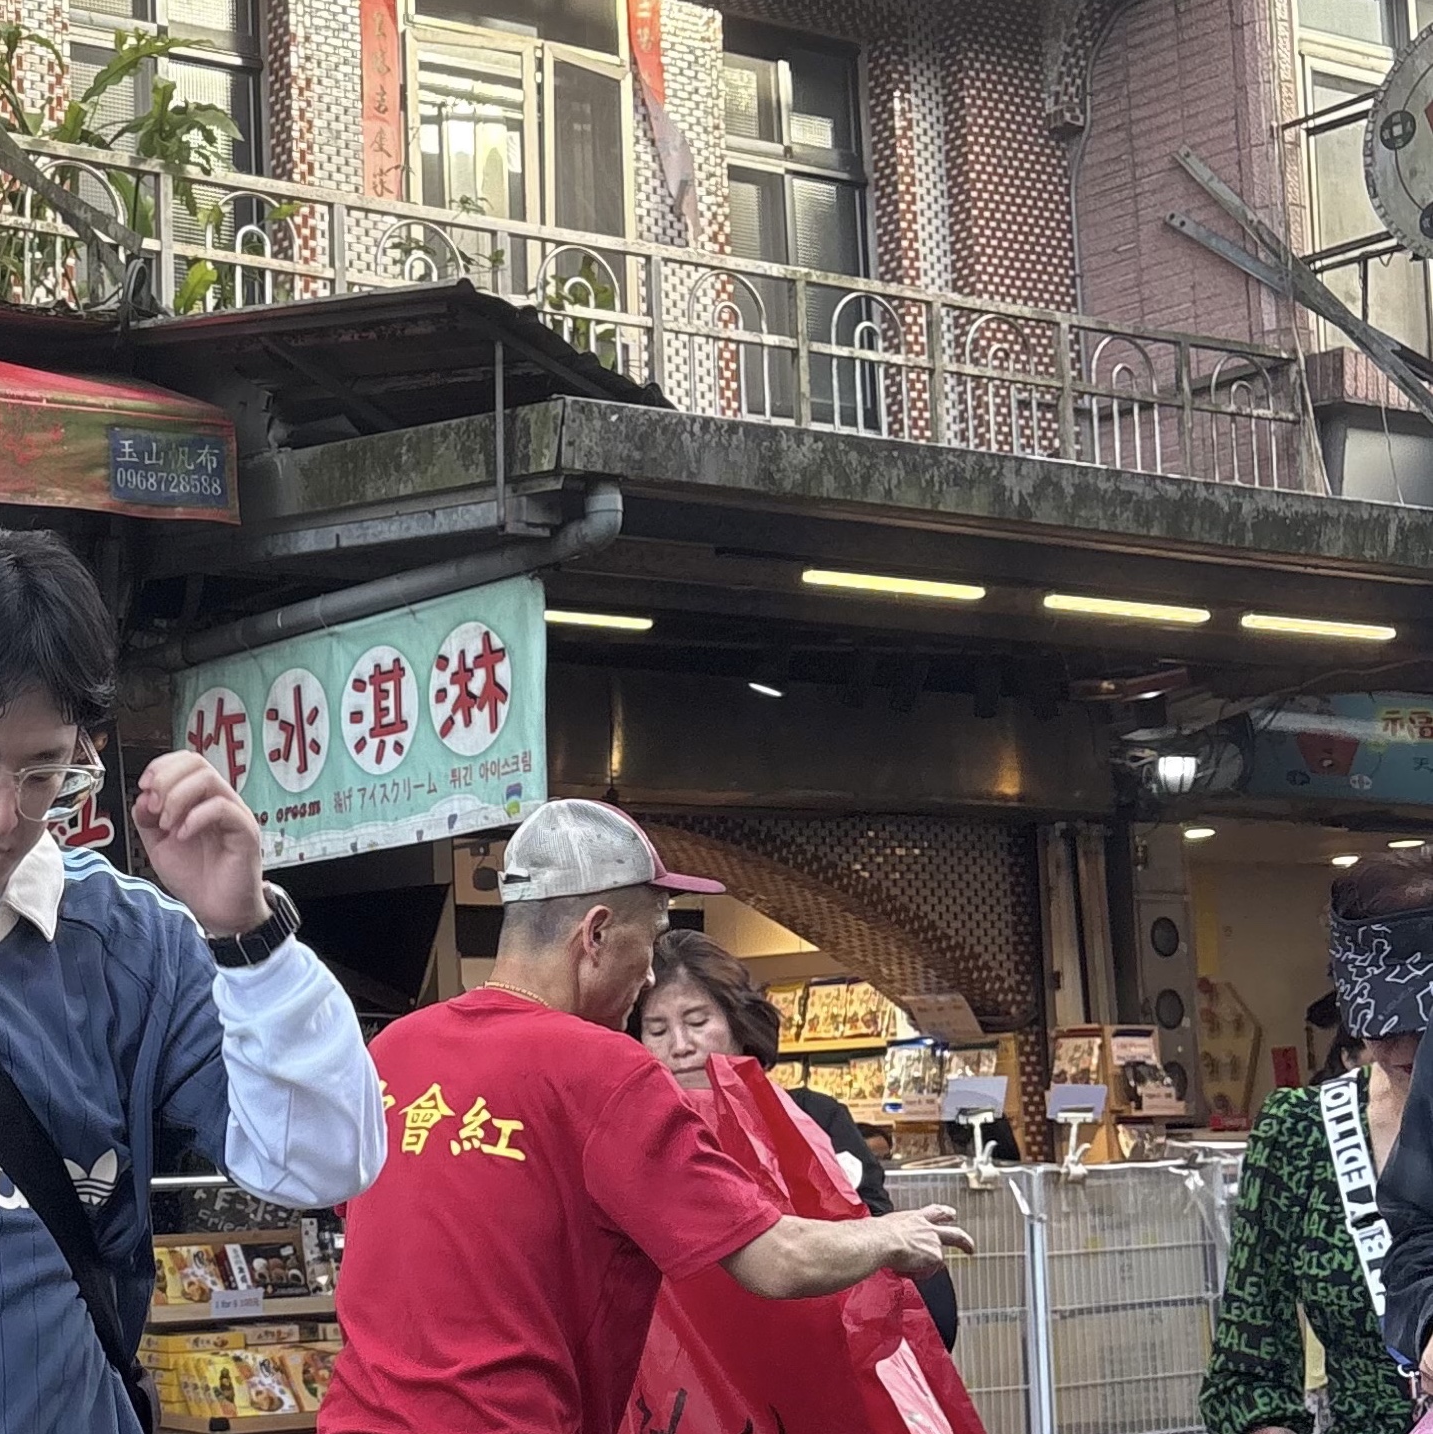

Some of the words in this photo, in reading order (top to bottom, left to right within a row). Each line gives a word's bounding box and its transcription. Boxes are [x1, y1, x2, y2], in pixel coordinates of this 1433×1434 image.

[115, 439, 220, 474] 玉山帆布
[116, 467, 222, 496] 0968728588
[187, 631, 509, 790] 炸冰淇淋
[449, 765, 473, 788] 튀긴
[479, 749, 533, 780] 아이스크림
[357, 772, 438, 808] アイスクリーム
